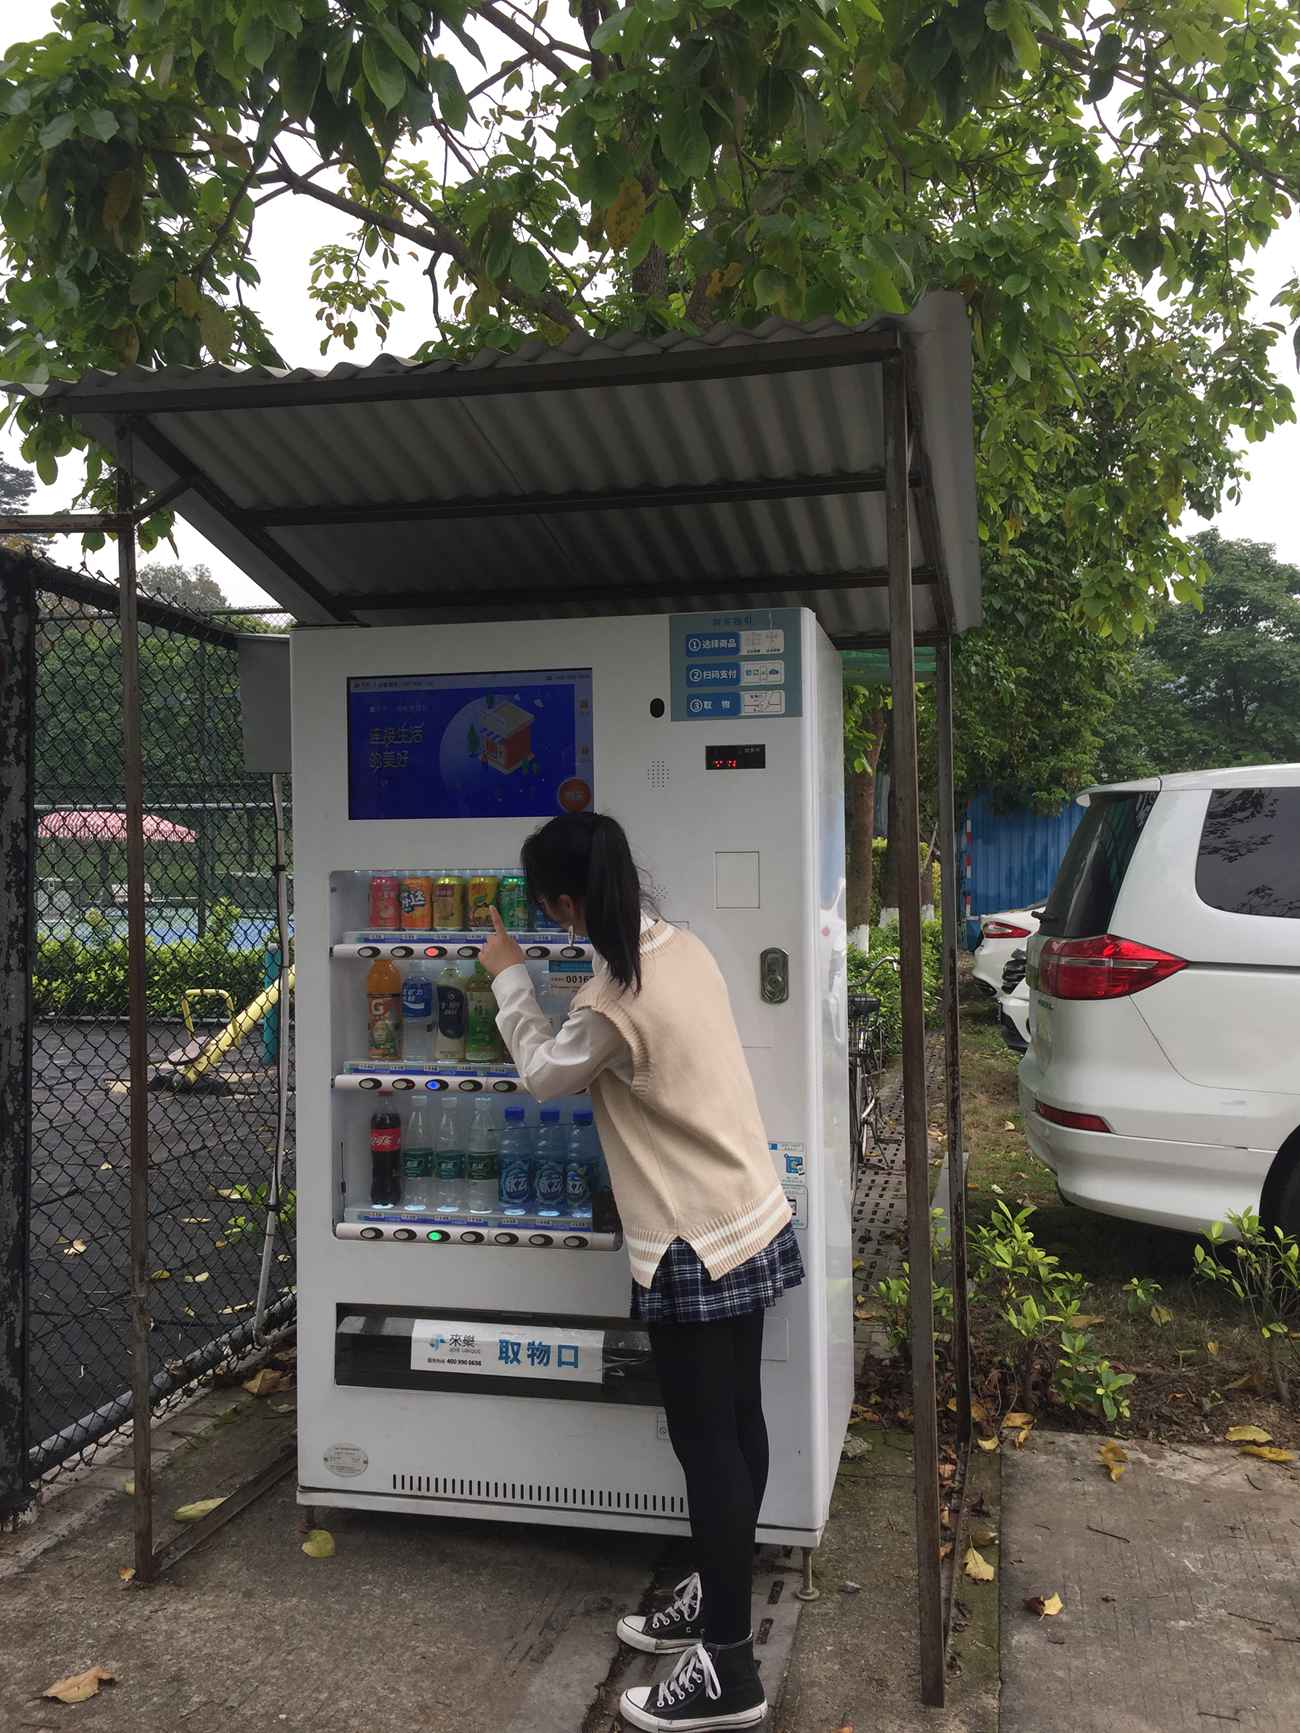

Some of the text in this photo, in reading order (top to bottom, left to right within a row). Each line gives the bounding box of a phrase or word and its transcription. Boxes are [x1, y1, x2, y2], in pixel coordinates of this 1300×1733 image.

[371, 999, 385, 1016] G
[498, 1338, 580, 1368] 取物口
